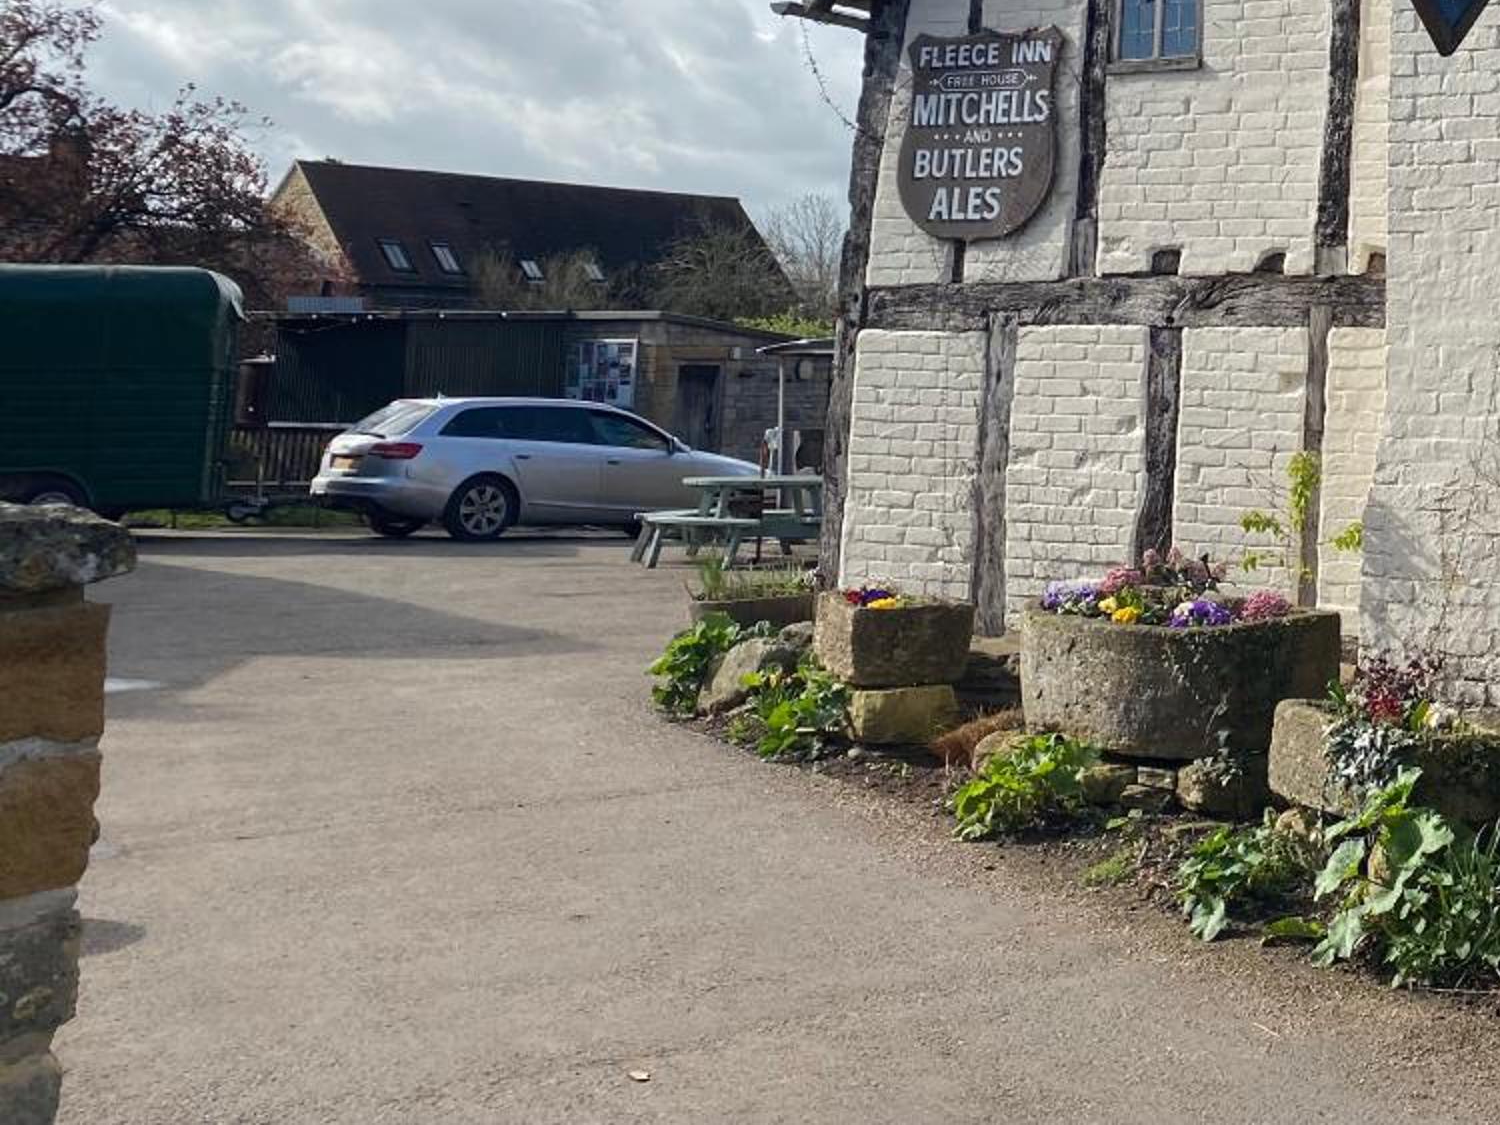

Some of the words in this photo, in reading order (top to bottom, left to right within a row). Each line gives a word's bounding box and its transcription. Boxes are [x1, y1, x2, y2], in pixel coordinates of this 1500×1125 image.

[919, 43, 1000, 69] FLEECE
[1011, 40, 1053, 65] INN
[947, 75, 975, 87] FREE
[981, 73, 1019, 86] HOUSE
[913, 89, 1050, 126] MITCHELLS
[963, 130, 992, 143] AND
[913, 147, 1023, 178] BUTLERS
[928, 186, 1002, 221] ALES
